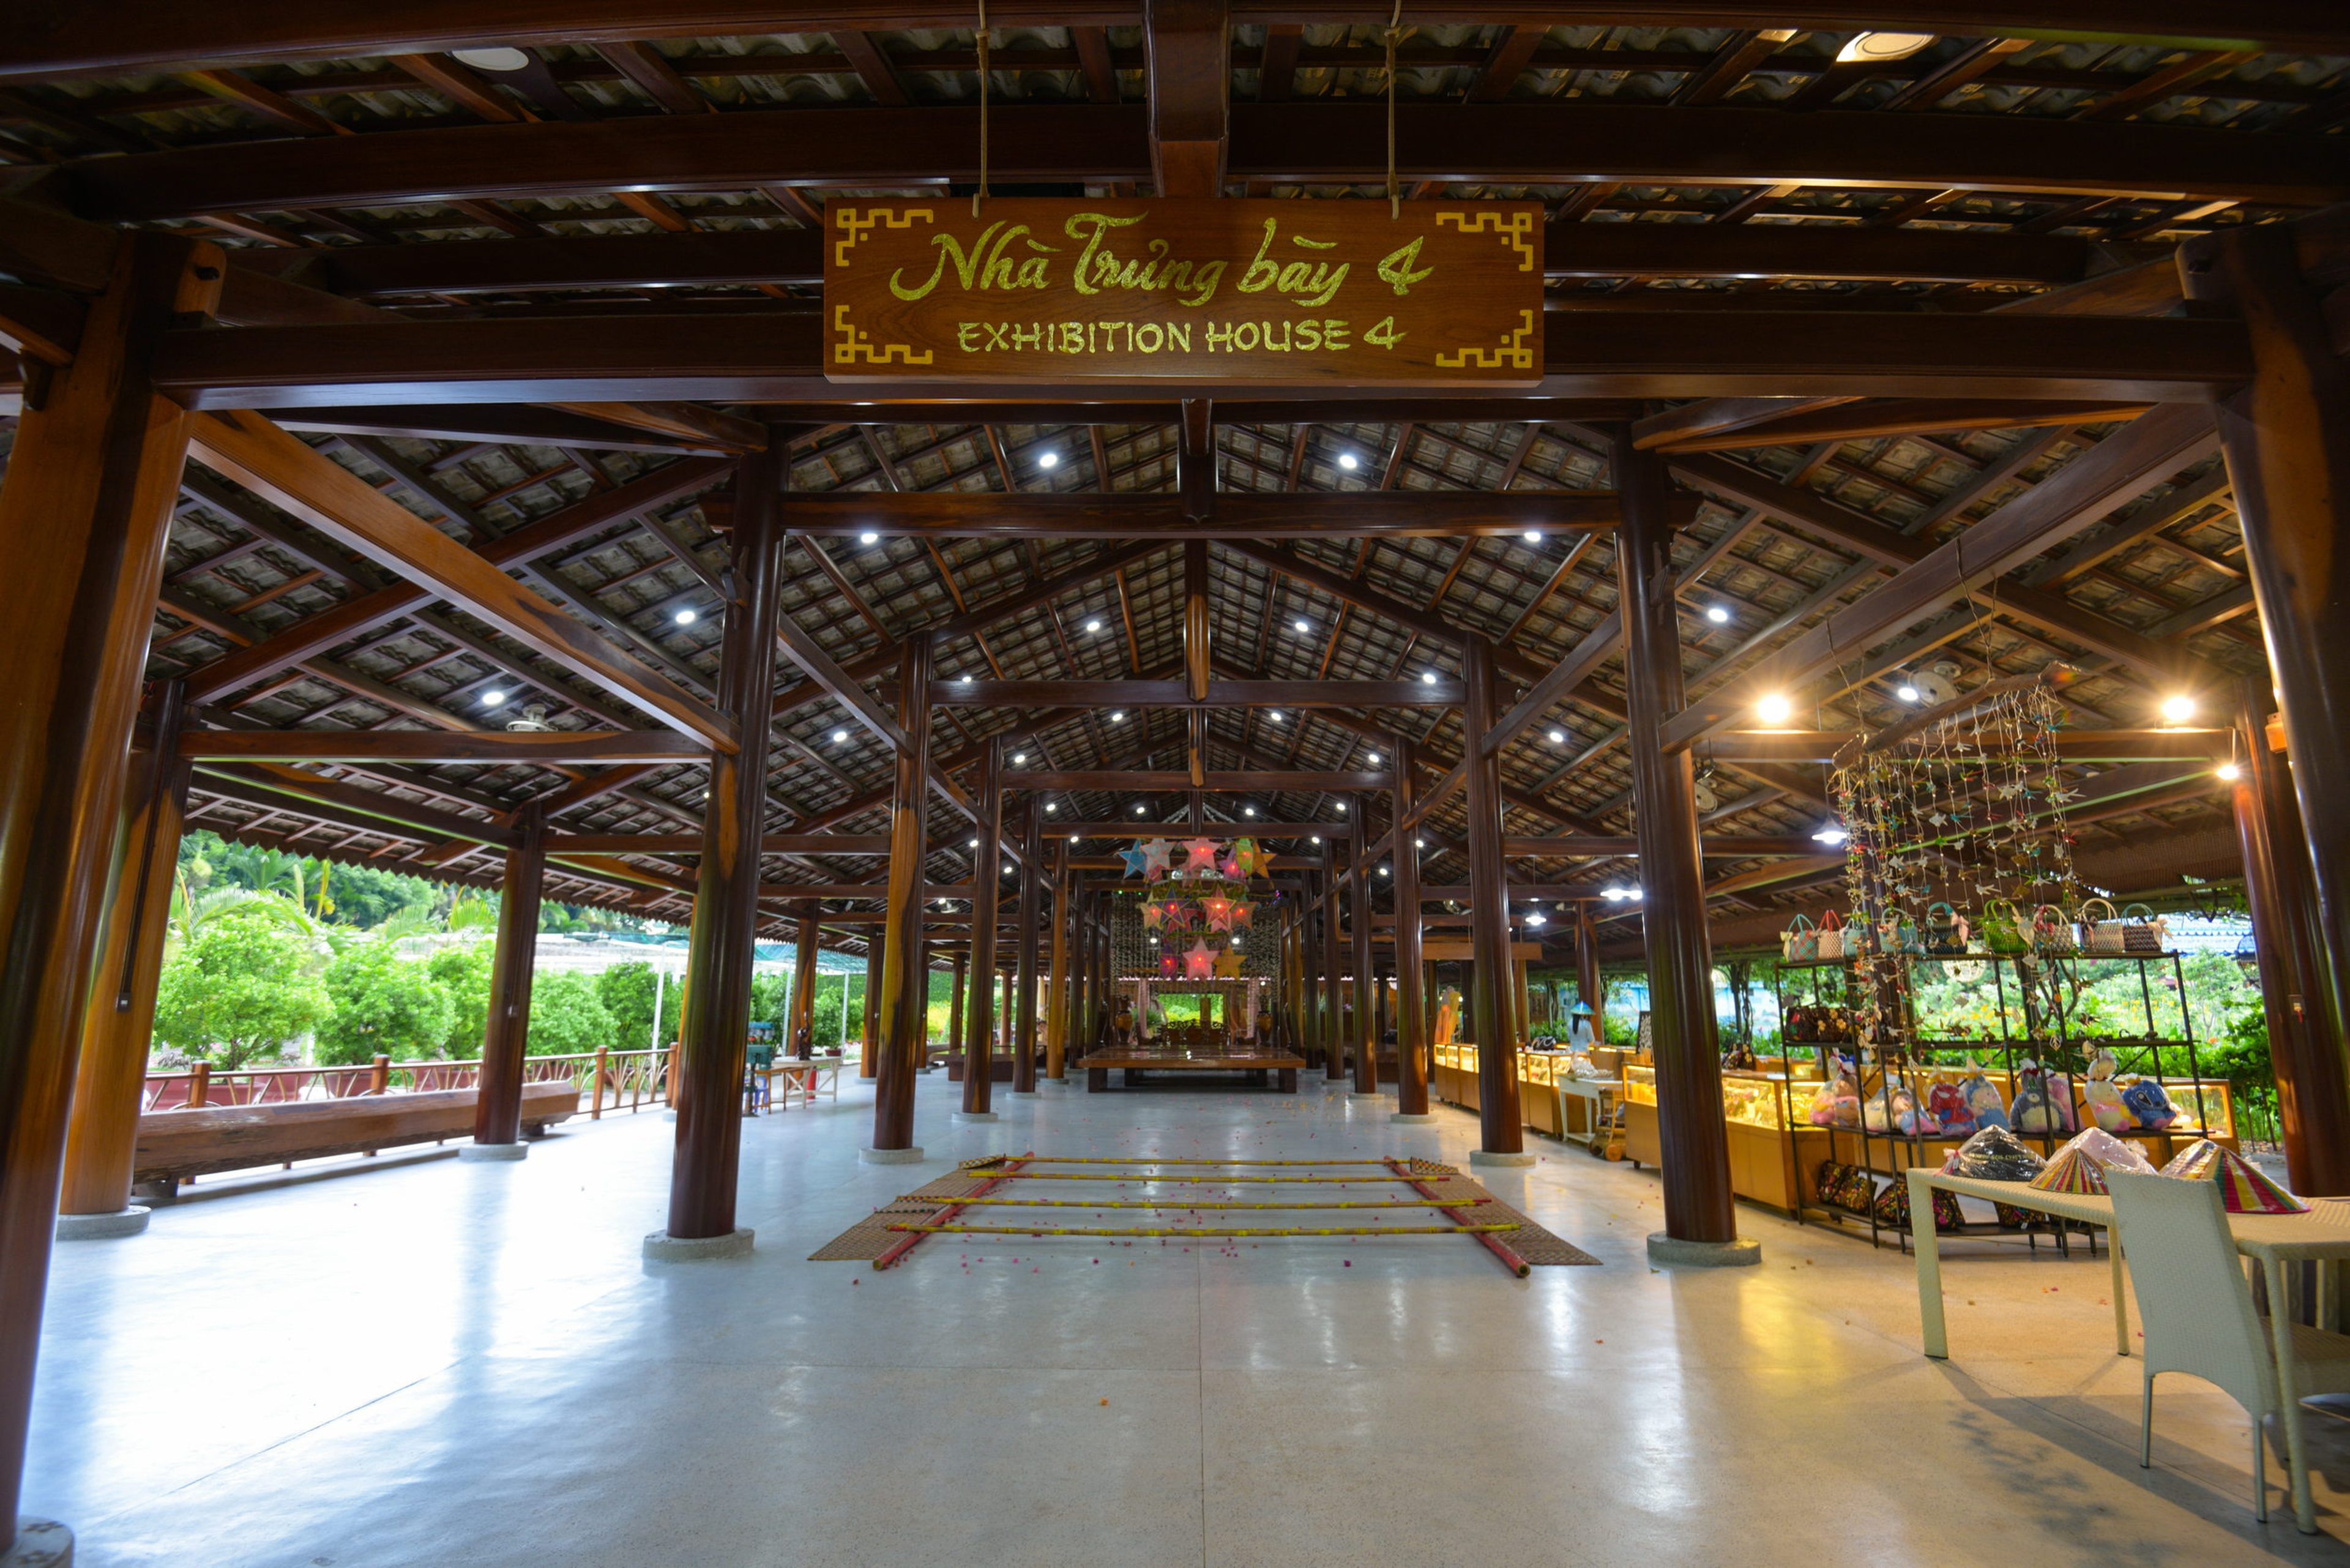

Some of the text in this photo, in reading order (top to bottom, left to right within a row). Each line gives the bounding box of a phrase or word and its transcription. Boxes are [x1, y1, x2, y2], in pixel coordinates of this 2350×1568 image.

[889, 220, 1064, 301] Nhà
[1236, 217, 1350, 307] bày
[1378, 236, 1434, 295] 4
[957, 316, 1408, 354] EXHIBITION HOUSE 4
